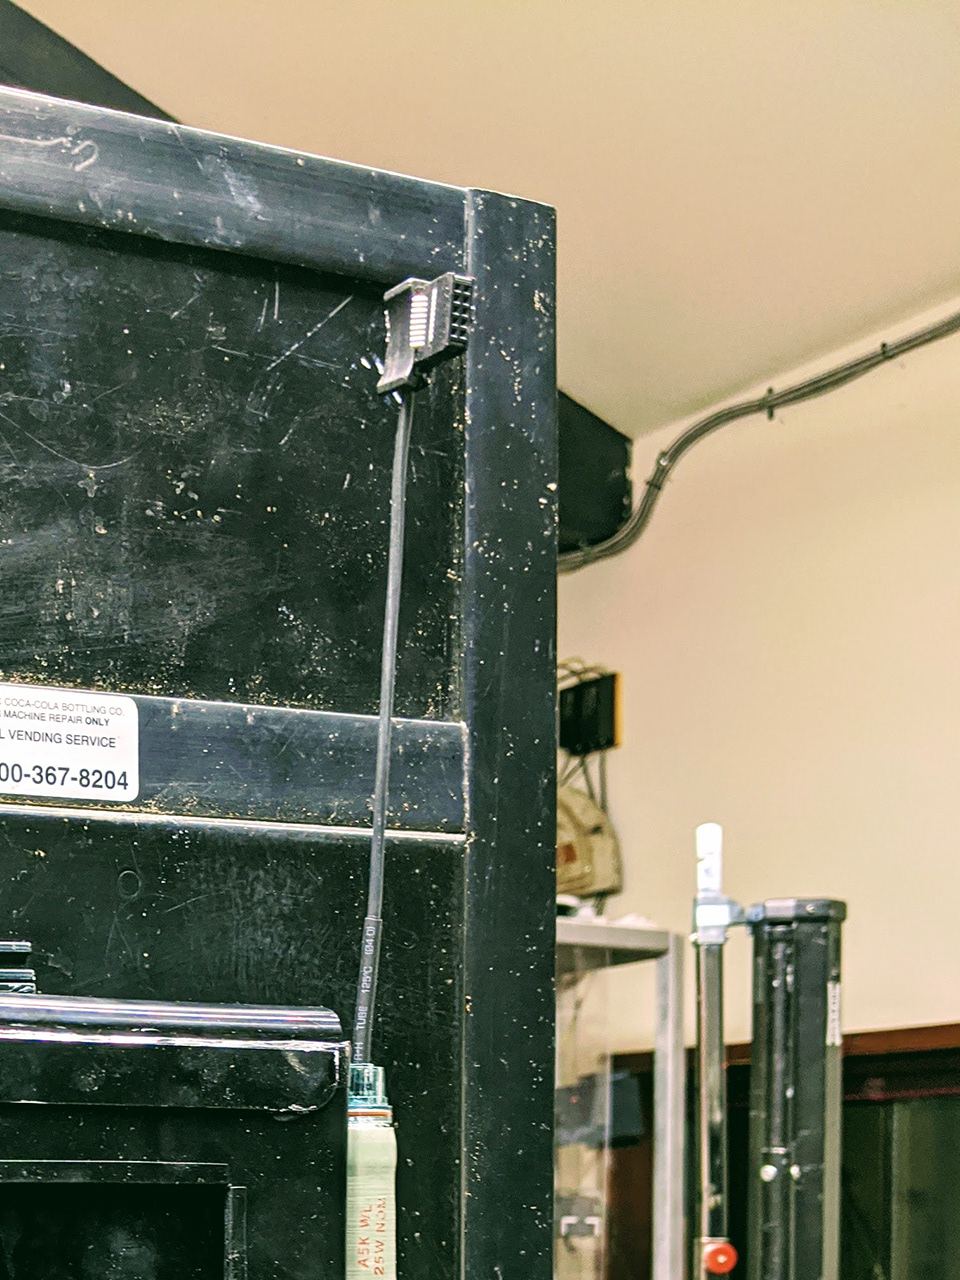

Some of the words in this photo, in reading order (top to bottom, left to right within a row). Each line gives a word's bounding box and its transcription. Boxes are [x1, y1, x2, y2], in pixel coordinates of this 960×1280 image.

[4, 698, 59, 710] COCA-COLA
[62, 703, 106, 715] BOTTLING
[109, 706, 125, 716] CO.
[4, 710, 46, 722] MACHINE
[49, 714, 82, 724] REPAIR
[85, 716, 110, 726] ONLY
[8, 729, 62, 744] VENDING
[66, 734, 116, 748] SERVICE
[356, 1006, 368, 1030] TUBE
[374, 1240, 384, 1275] 25W
